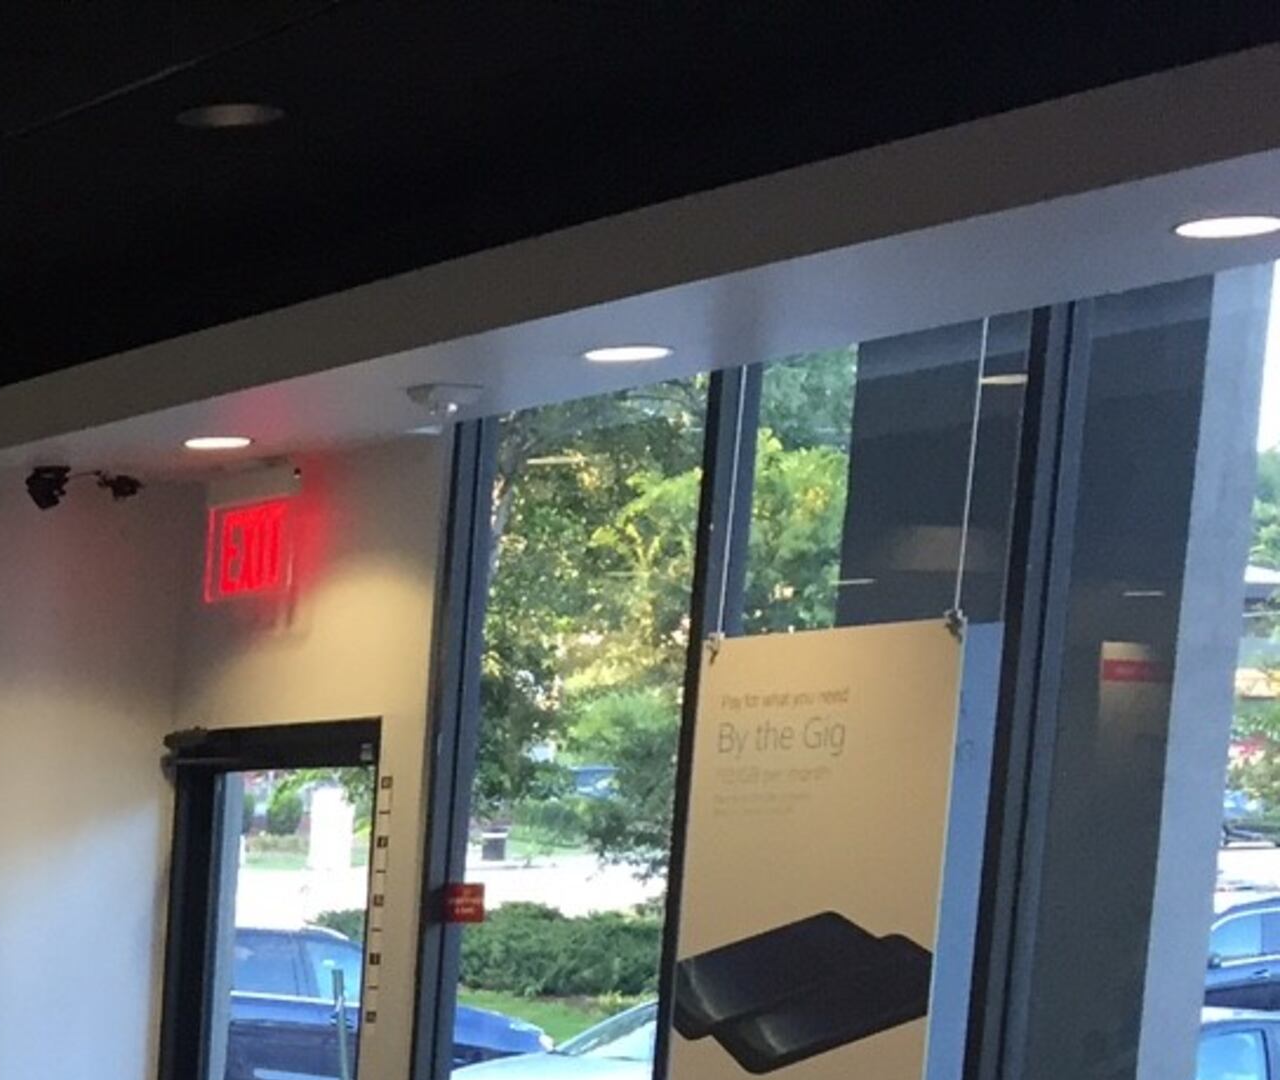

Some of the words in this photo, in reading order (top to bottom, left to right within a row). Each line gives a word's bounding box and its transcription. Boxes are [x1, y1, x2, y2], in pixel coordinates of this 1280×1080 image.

[718, 722, 749, 760] By
[755, 719, 795, 751] the
[803, 714, 846, 758] Gig
